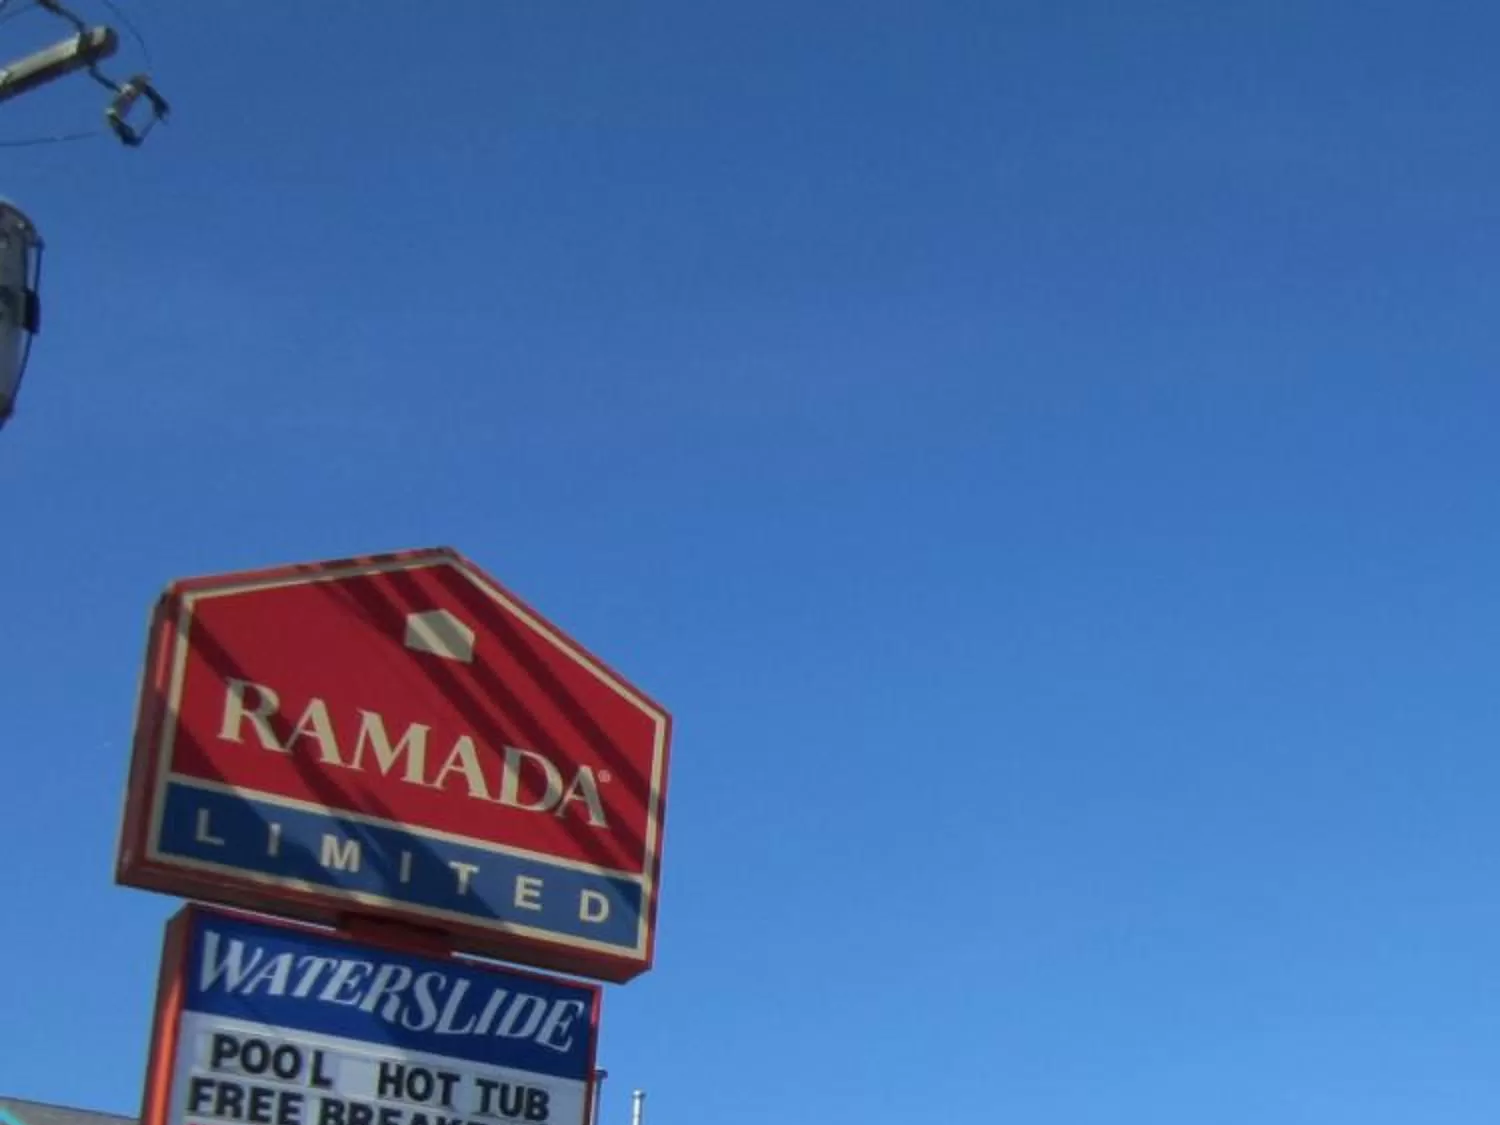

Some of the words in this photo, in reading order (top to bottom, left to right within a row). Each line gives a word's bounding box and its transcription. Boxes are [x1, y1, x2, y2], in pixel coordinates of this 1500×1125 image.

[216, 676, 609, 829] RAMADA
[195, 807, 610, 924] LIMITED
[200, 931, 584, 1052] WATERSLIDE
[211, 1033, 333, 1088] POOL
[377, 1062, 460, 1108] HOT
[475, 1077, 549, 1122] TUB
